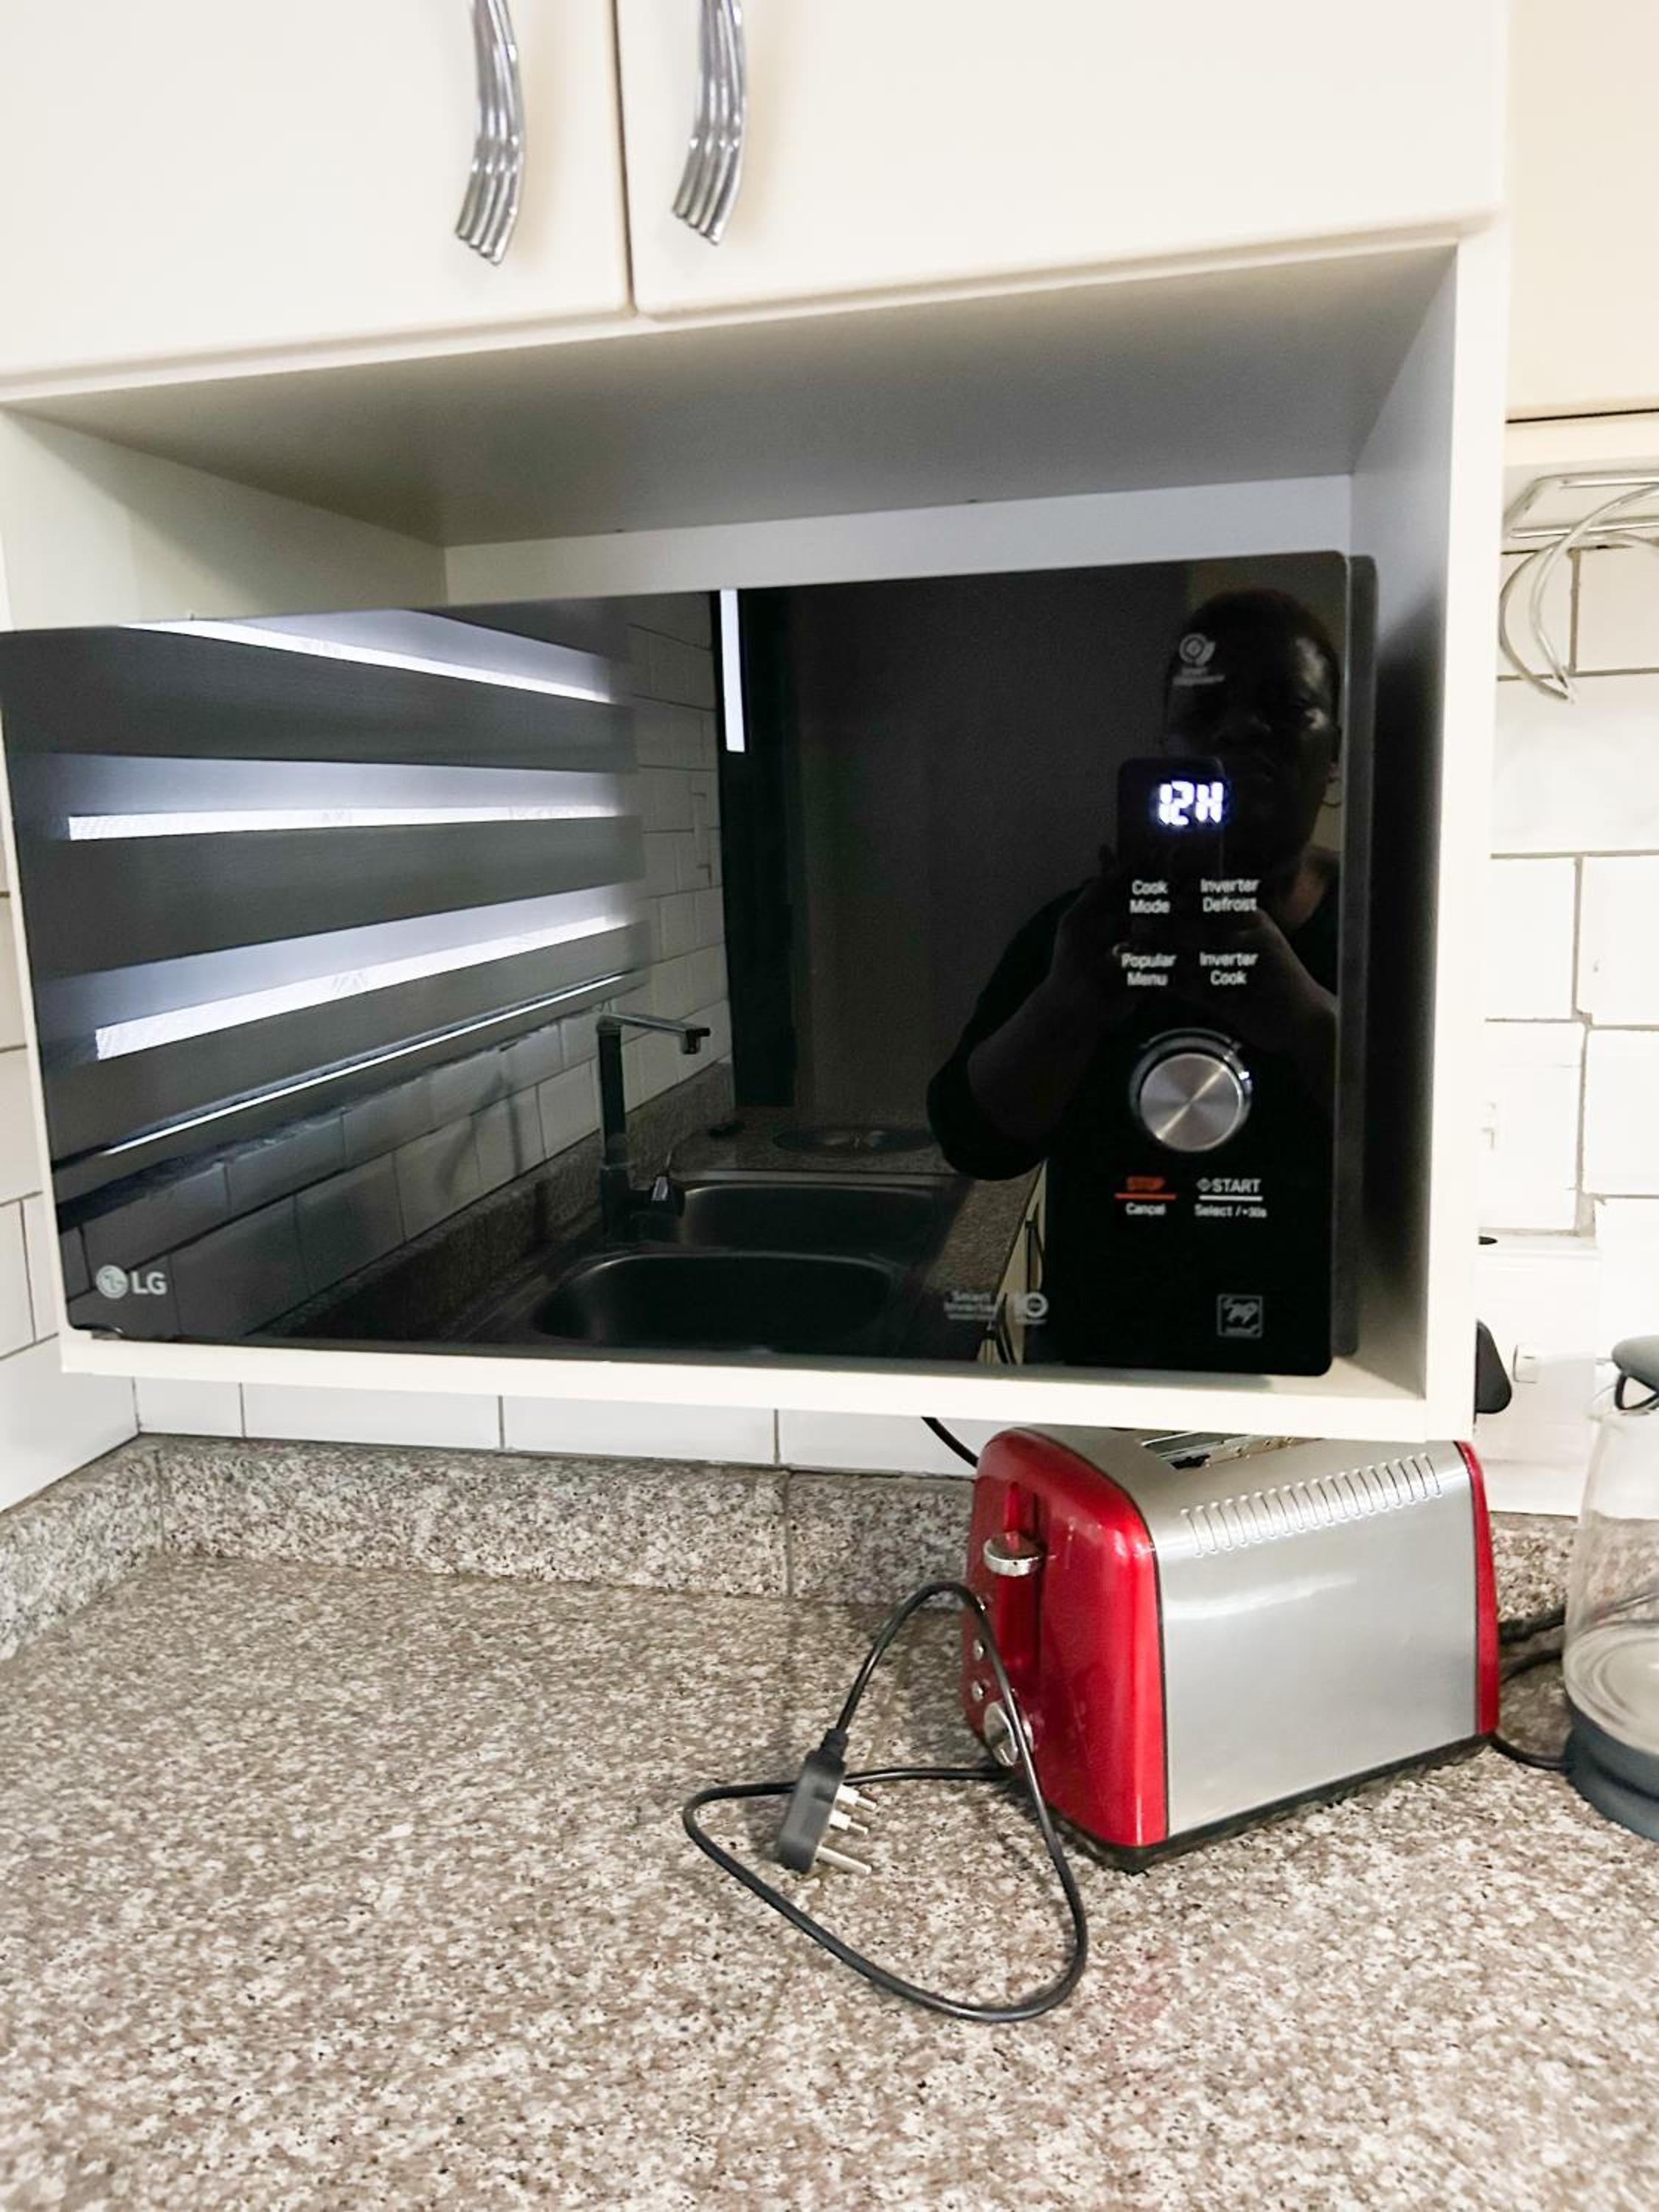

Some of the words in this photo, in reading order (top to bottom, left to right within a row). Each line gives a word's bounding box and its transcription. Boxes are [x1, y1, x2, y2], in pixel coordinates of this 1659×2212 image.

[1158, 780, 1224, 826] 12H
[1132, 880, 1168, 895] Cook
[1200, 878, 1260, 893] Inverter
[1129, 899, 1171, 914] Mode
[1203, 897, 1256, 913] Defrost
[1121, 953, 1177, 968] Popular
[1200, 952, 1259, 967] Inverter
[1127, 971, 1169, 987] Menu
[1210, 970, 1247, 985] Cook
[1211, 1178, 1262, 1193] START
[1194, 1203, 1234, 1217] Select
[131, 1271, 167, 1295] LG
